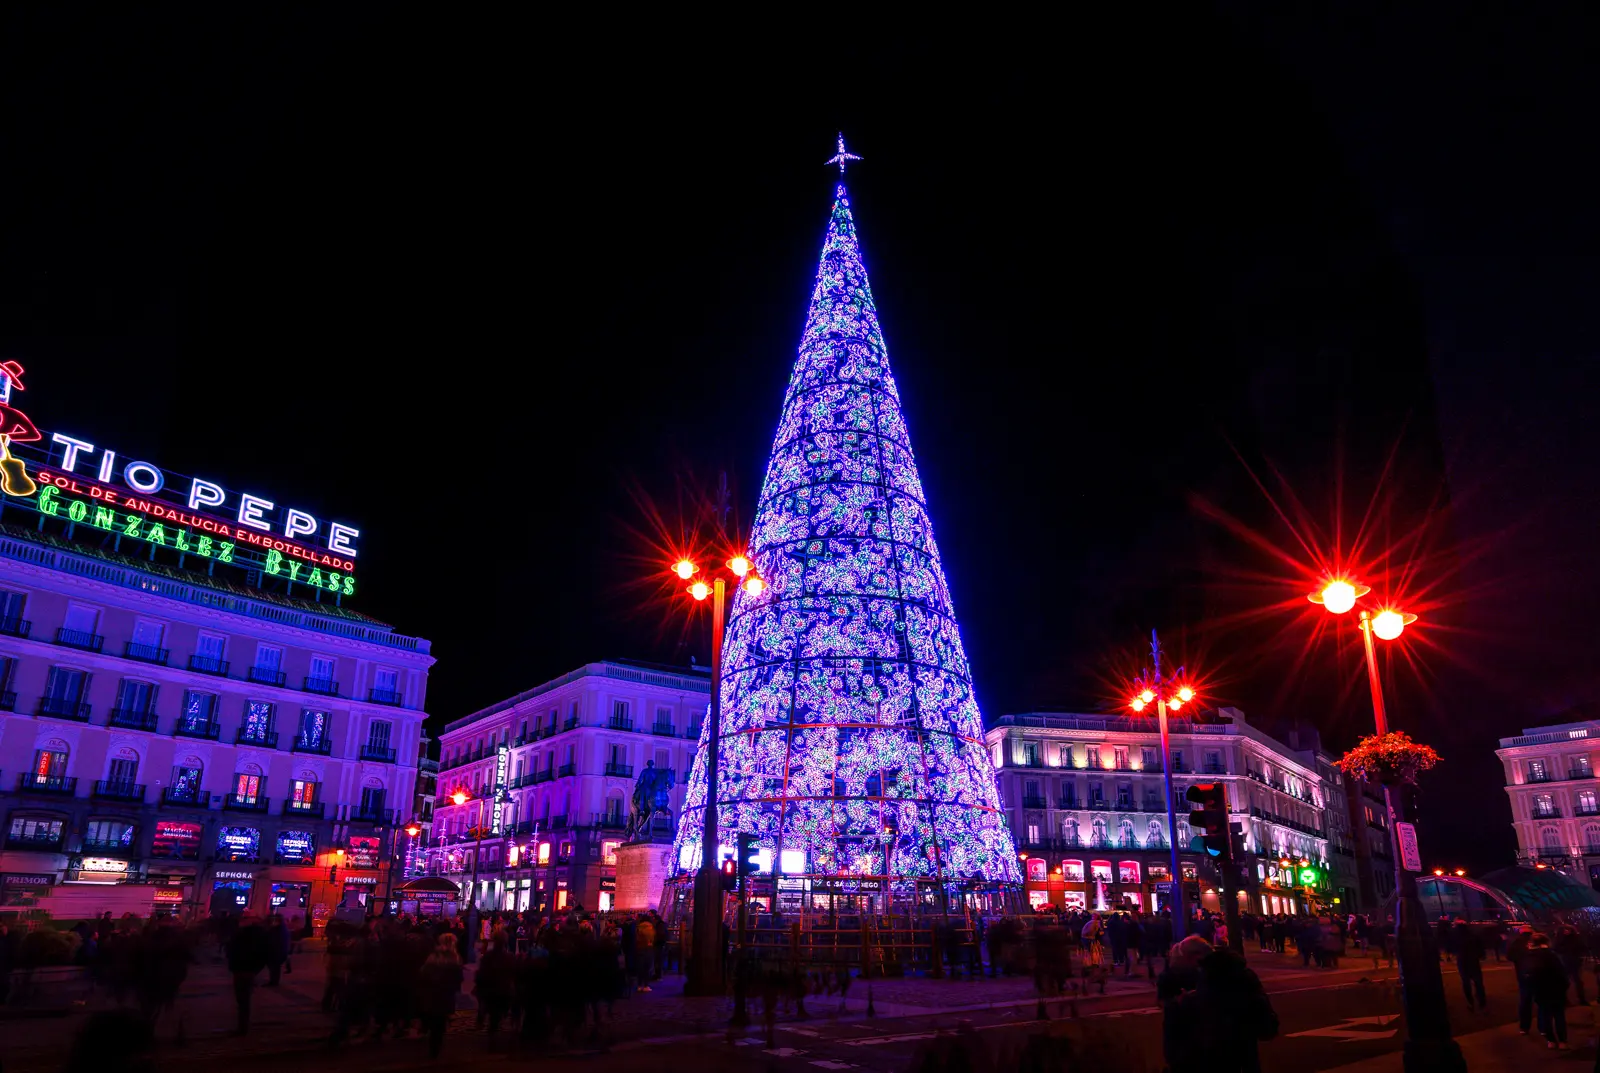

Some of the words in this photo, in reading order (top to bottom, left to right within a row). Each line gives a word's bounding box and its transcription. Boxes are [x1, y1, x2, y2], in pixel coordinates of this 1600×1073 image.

[52, 432, 164, 494] TIO
[188, 477, 359, 557] PEPE
[38, 471, 82, 494] SOL
[91, 486, 117, 503] DE
[125, 498, 229, 536] ANDALUCIA
[236, 529, 354, 571] EMBOTELLADO
[40, 485, 235, 563] GONZALEZ
[265, 548, 355, 595] BYASS
[497, 747, 507, 784] HOTEL
[6, 876, 48, 884] PRIMOR
[215, 871, 253, 879] SEPHORA
[345, 876, 377, 884] SEPHORA
